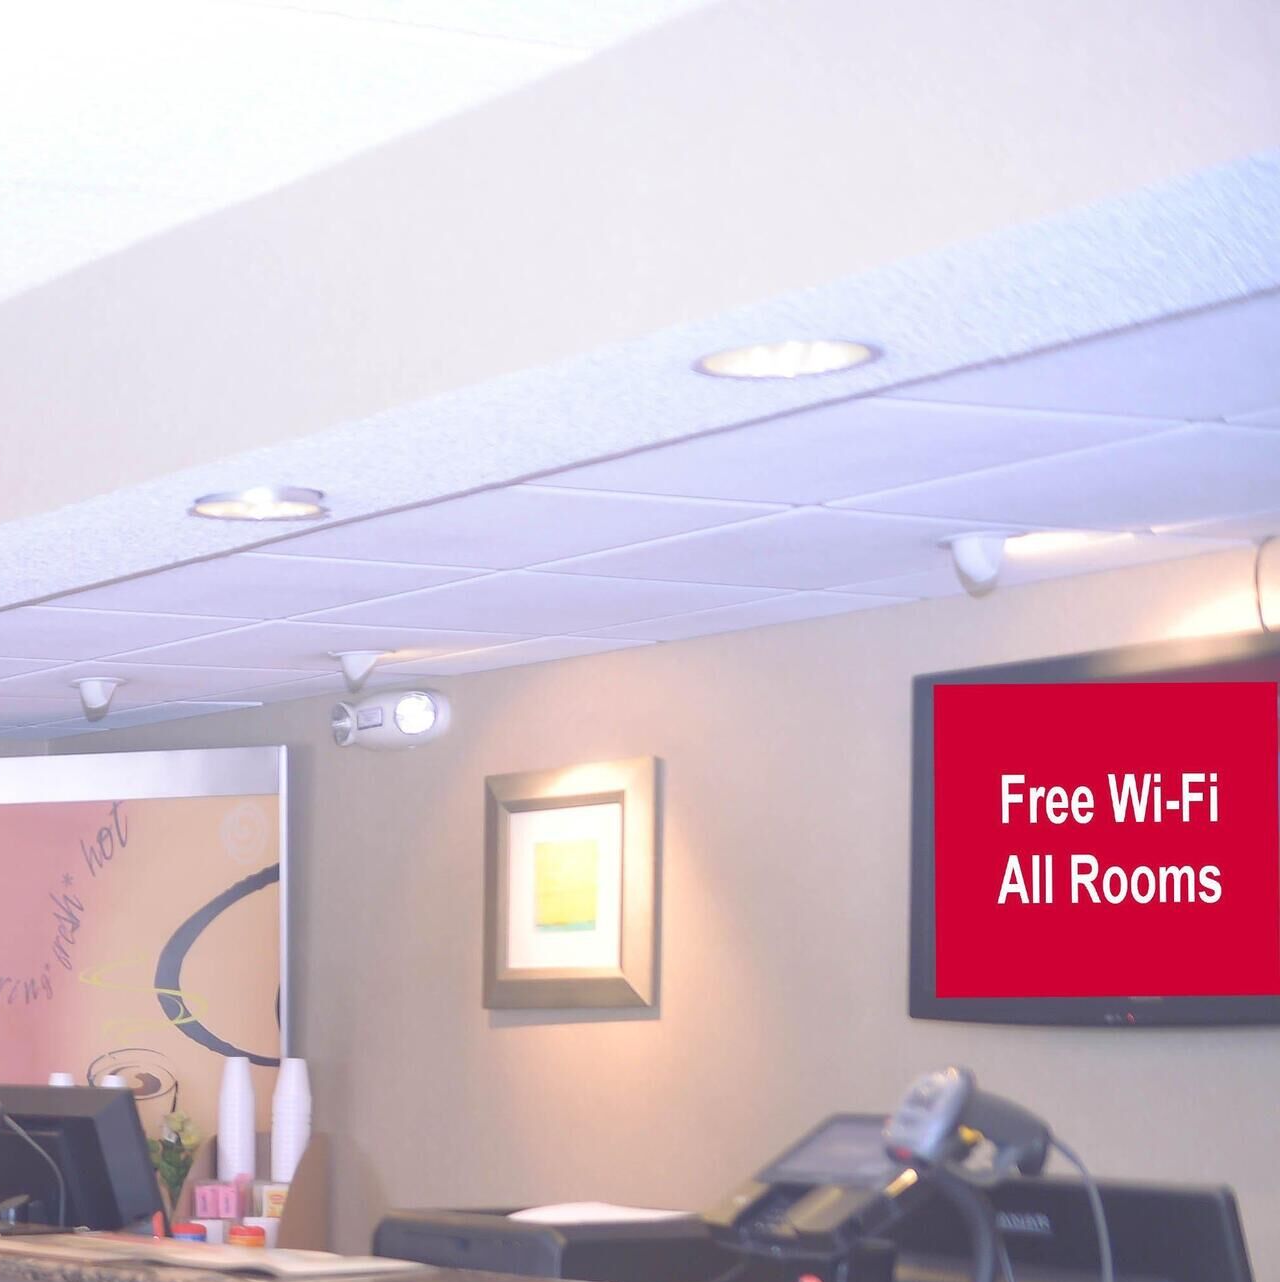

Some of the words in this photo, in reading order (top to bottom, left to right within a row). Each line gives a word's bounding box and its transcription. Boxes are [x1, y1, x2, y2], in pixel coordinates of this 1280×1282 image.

[1001, 774, 1095, 825] Free
[1108, 772, 1218, 823] Wi-Fi
[80, 800, 130, 877] hot
[997, 854, 1053, 904] All
[1071, 854, 1222, 904] Rooms
